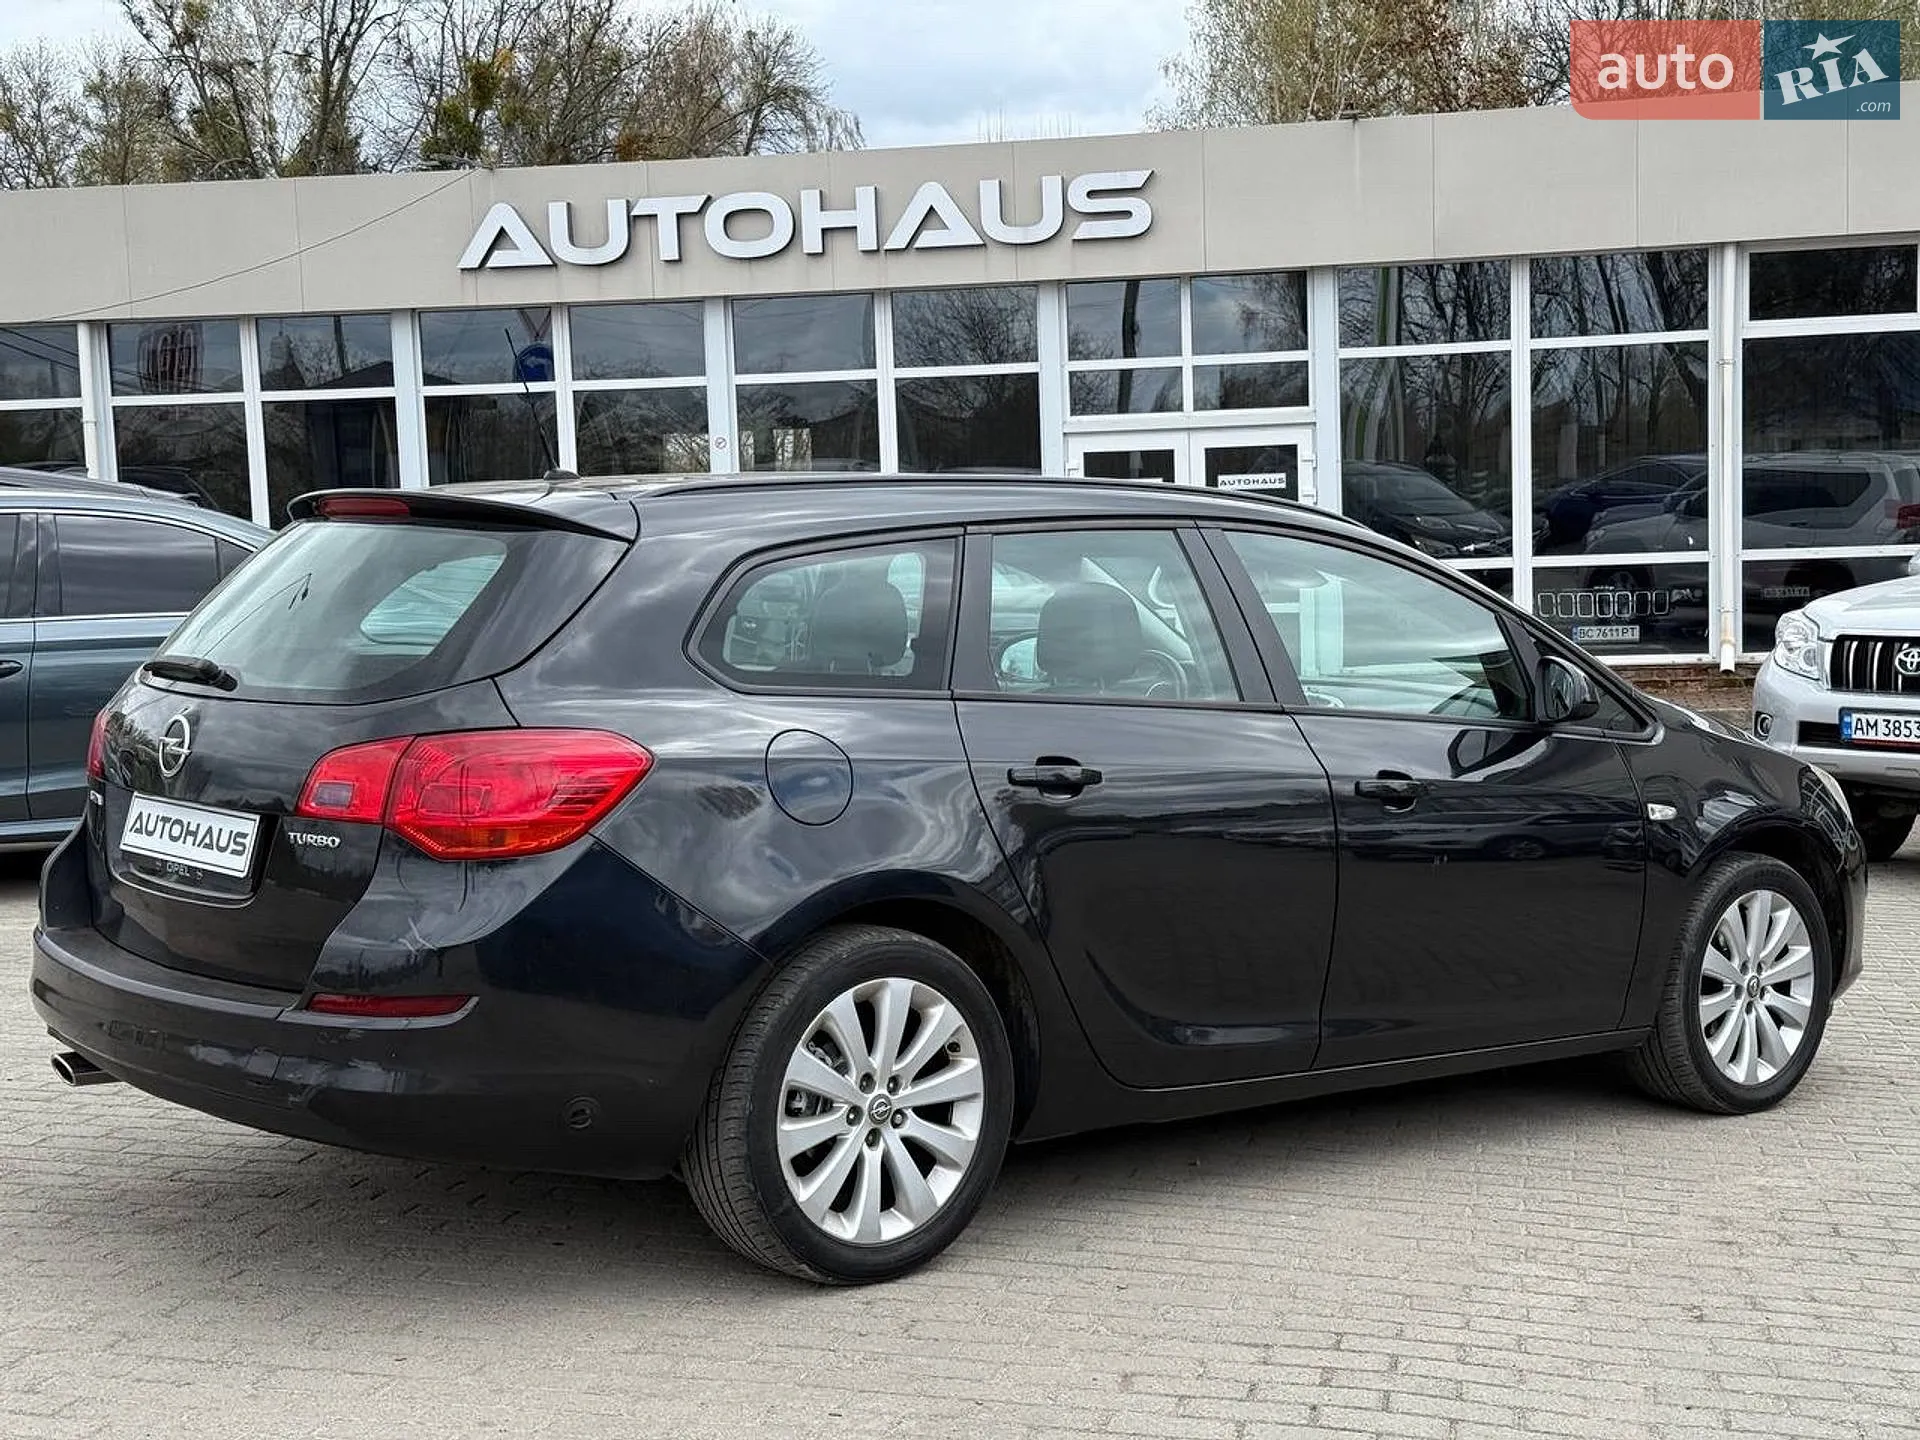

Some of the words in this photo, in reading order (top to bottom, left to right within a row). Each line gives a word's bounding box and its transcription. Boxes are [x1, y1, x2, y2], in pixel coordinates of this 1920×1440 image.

[457, 169, 1154, 269] AUTOHAUS
[1219, 477, 1285, 486] AUTOHAUS
[1854, 718, 1878, 736] AM
[1883, 718, 1920, 739] 3853
[129, 810, 250, 856] AUTOHAUS
[287, 832, 341, 848] TURBO
[166, 861, 190, 877] OPEL
